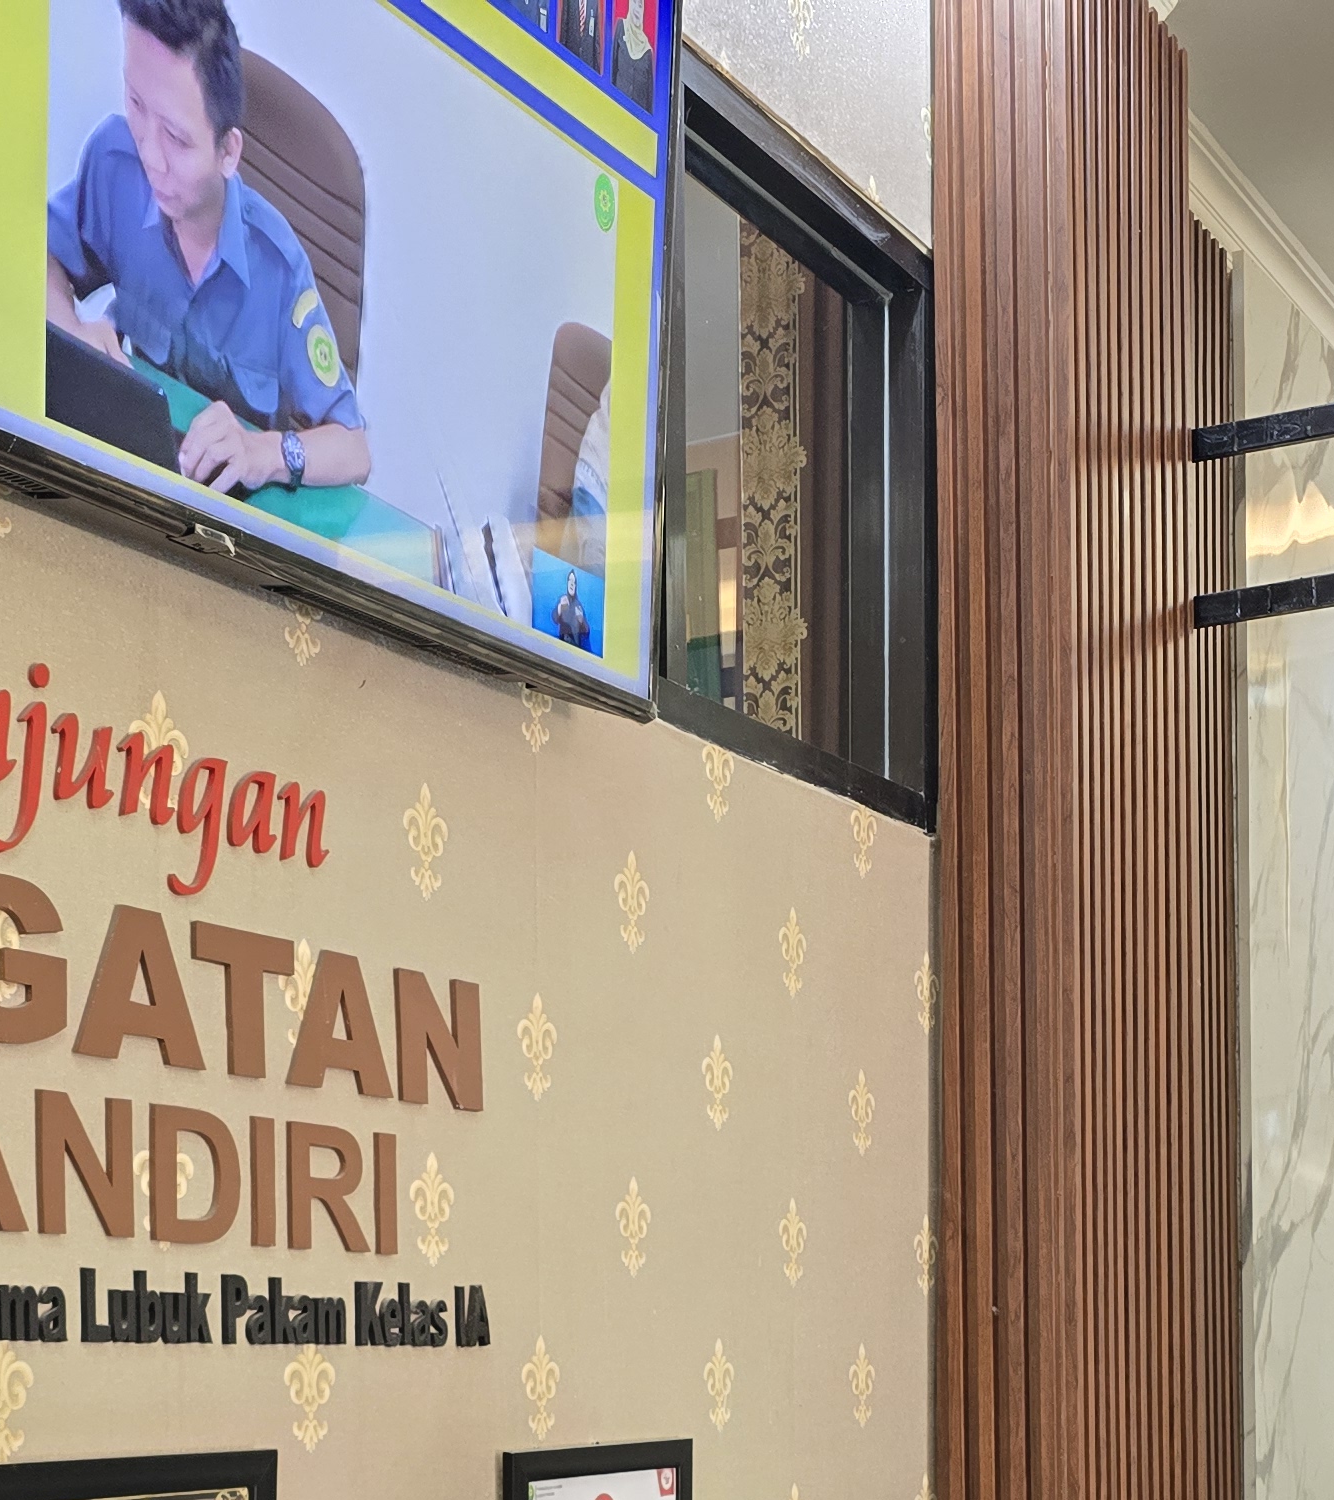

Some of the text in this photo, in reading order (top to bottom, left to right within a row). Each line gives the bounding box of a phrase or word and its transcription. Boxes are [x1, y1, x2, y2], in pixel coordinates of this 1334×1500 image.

[78, 1266, 212, 1344] Lubuk
[220, 1272, 347, 1346] Pakam
[354, 1280, 450, 1347] Kelas
[454, 1283, 491, 1347] IA
